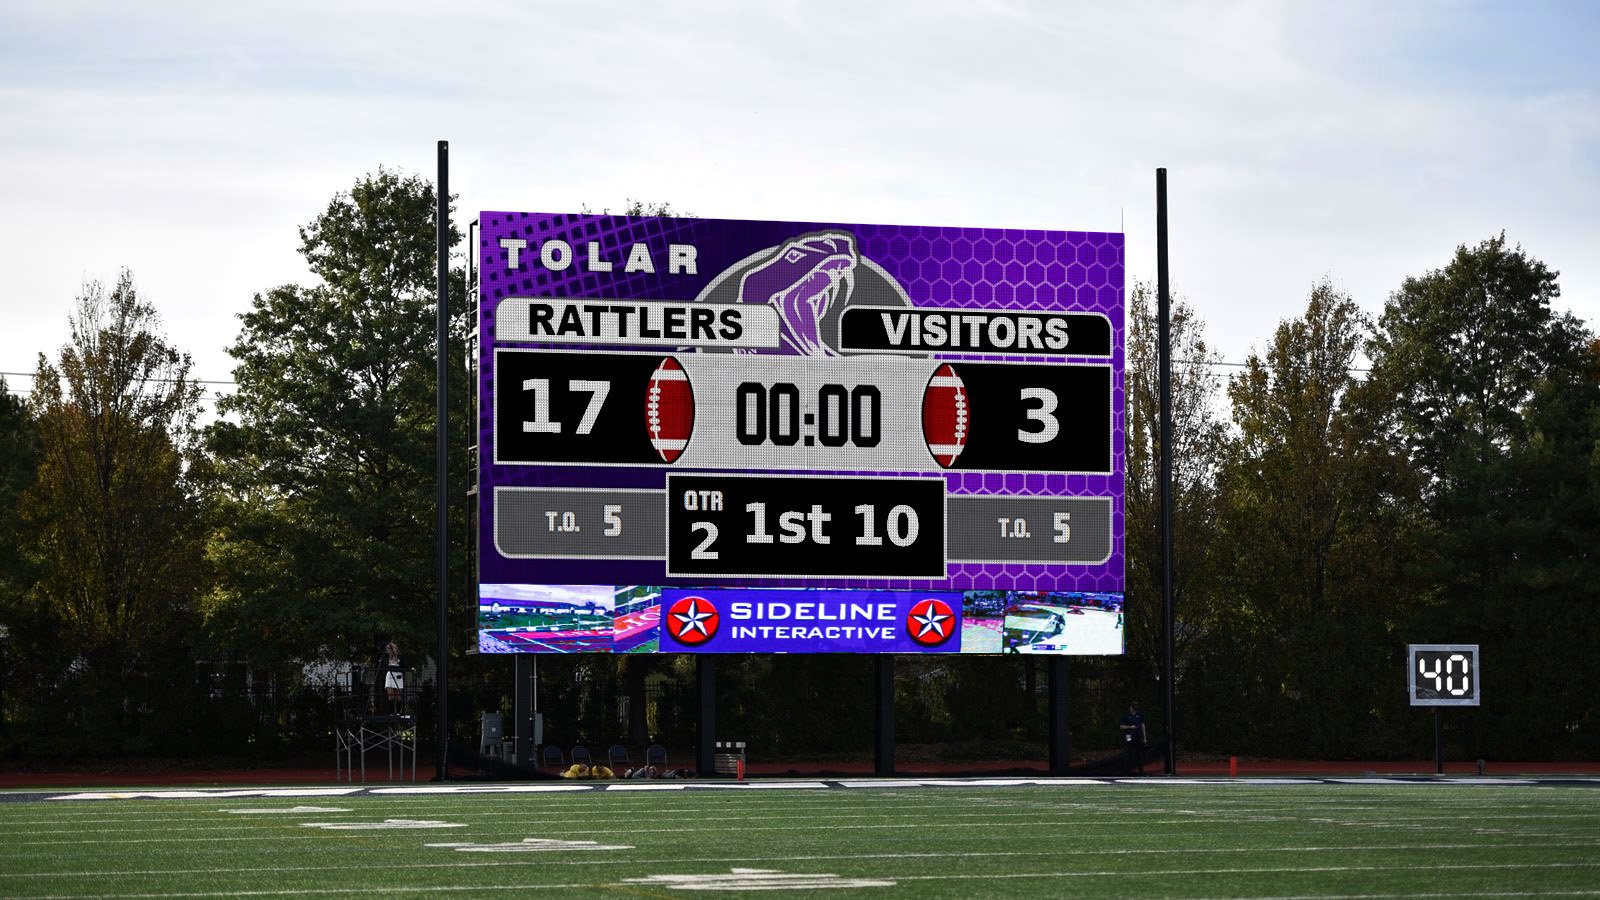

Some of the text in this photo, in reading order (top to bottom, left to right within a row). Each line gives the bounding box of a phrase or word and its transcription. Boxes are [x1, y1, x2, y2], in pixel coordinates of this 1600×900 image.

[499, 238, 698, 275] TOLAR
[528, 303, 743, 340] RATTLERS
[880, 312, 1070, 350] VISITORS
[522, 378, 611, 435] 17
[736, 382, 881, 448] 00:00
[1017, 387, 1060, 443] 3
[683, 490, 724, 511] QTR
[545, 504, 622, 537] T.O. 5
[745, 502, 920, 548] 1st 10
[998, 512, 1071, 544] T.O. 5
[691, 521, 719, 560] 2
[730, 602, 897, 620] SIDELINE
[731, 626, 896, 640] INTERACTIVE
[1419, 654, 1469, 696] 40
